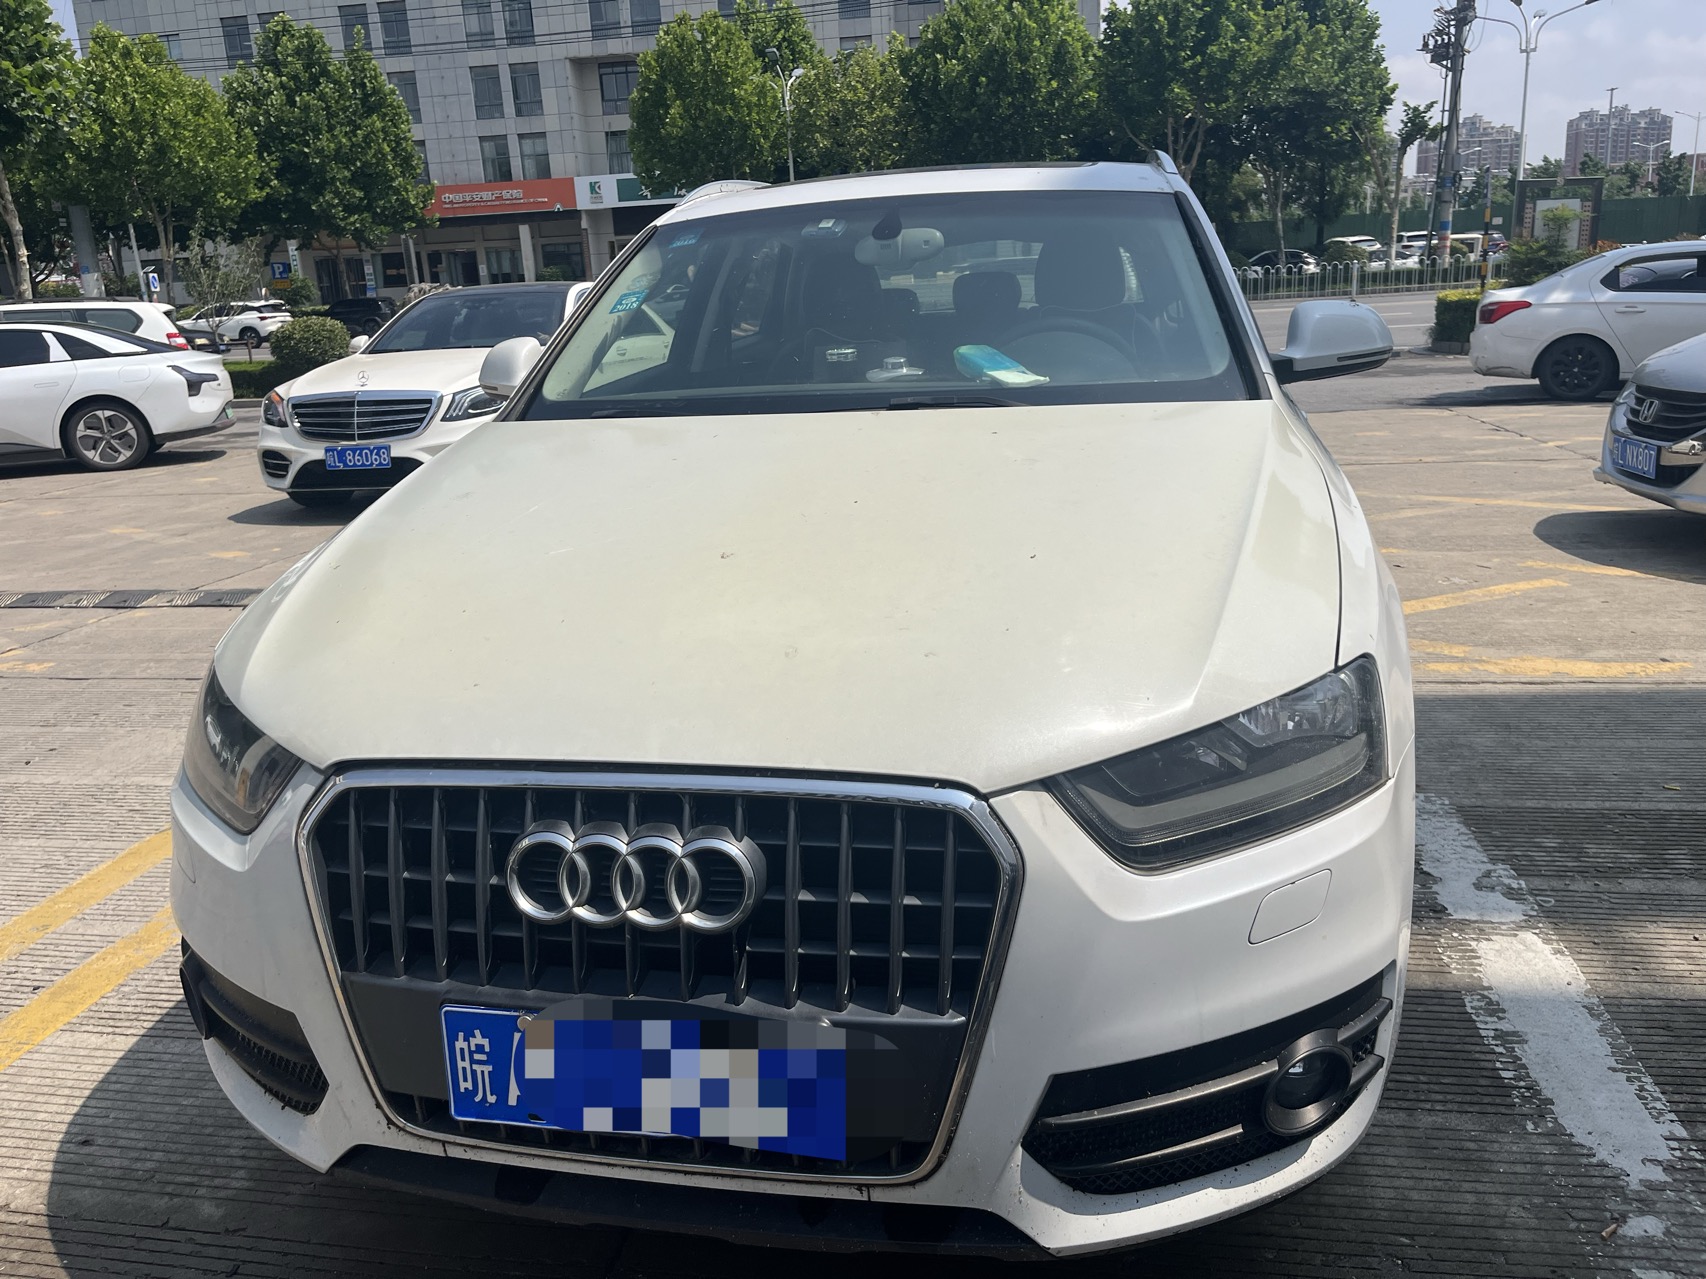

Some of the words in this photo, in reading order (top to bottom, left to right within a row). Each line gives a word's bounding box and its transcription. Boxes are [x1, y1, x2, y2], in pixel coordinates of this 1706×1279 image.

[441, 189, 523, 203] 中国平安财产保险
